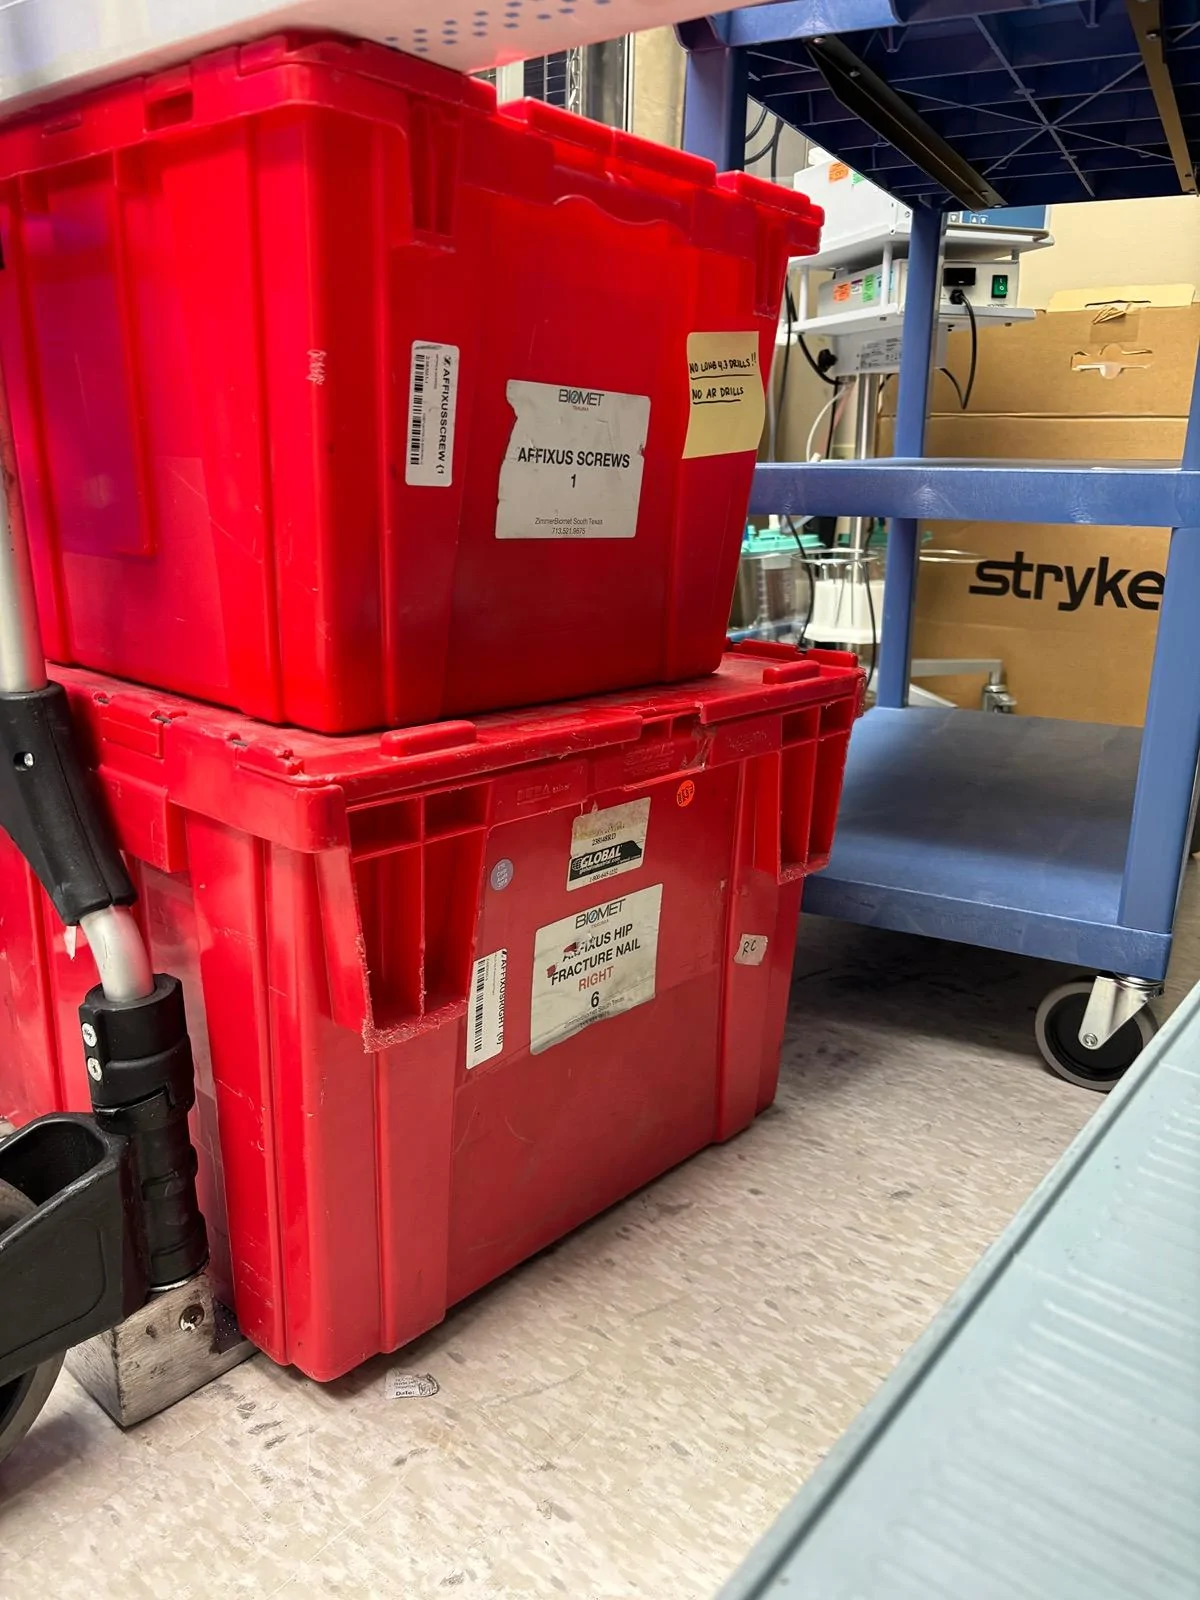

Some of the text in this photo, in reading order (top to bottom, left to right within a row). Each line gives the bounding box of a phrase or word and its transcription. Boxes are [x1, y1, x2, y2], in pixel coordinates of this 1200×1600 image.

[689, 362, 699, 374] NO
[558, 388, 604, 407] BIOMET
[692, 386, 744, 401] NO AR DRILLS
[438, 368, 450, 461] AFFIXUSSCREW
[518, 447, 631, 469] AFFIXUS SCREWS
[571, 473, 577, 489] 1
[580, 845, 622, 868] GLOBAL
[575, 898, 626, 930] BIOMET
[614, 923, 633, 941] HIP
[551, 938, 641, 986] FRACTURE NAIL
[578, 965, 614, 992] RIGHT
[590, 990, 600, 1008] 6
